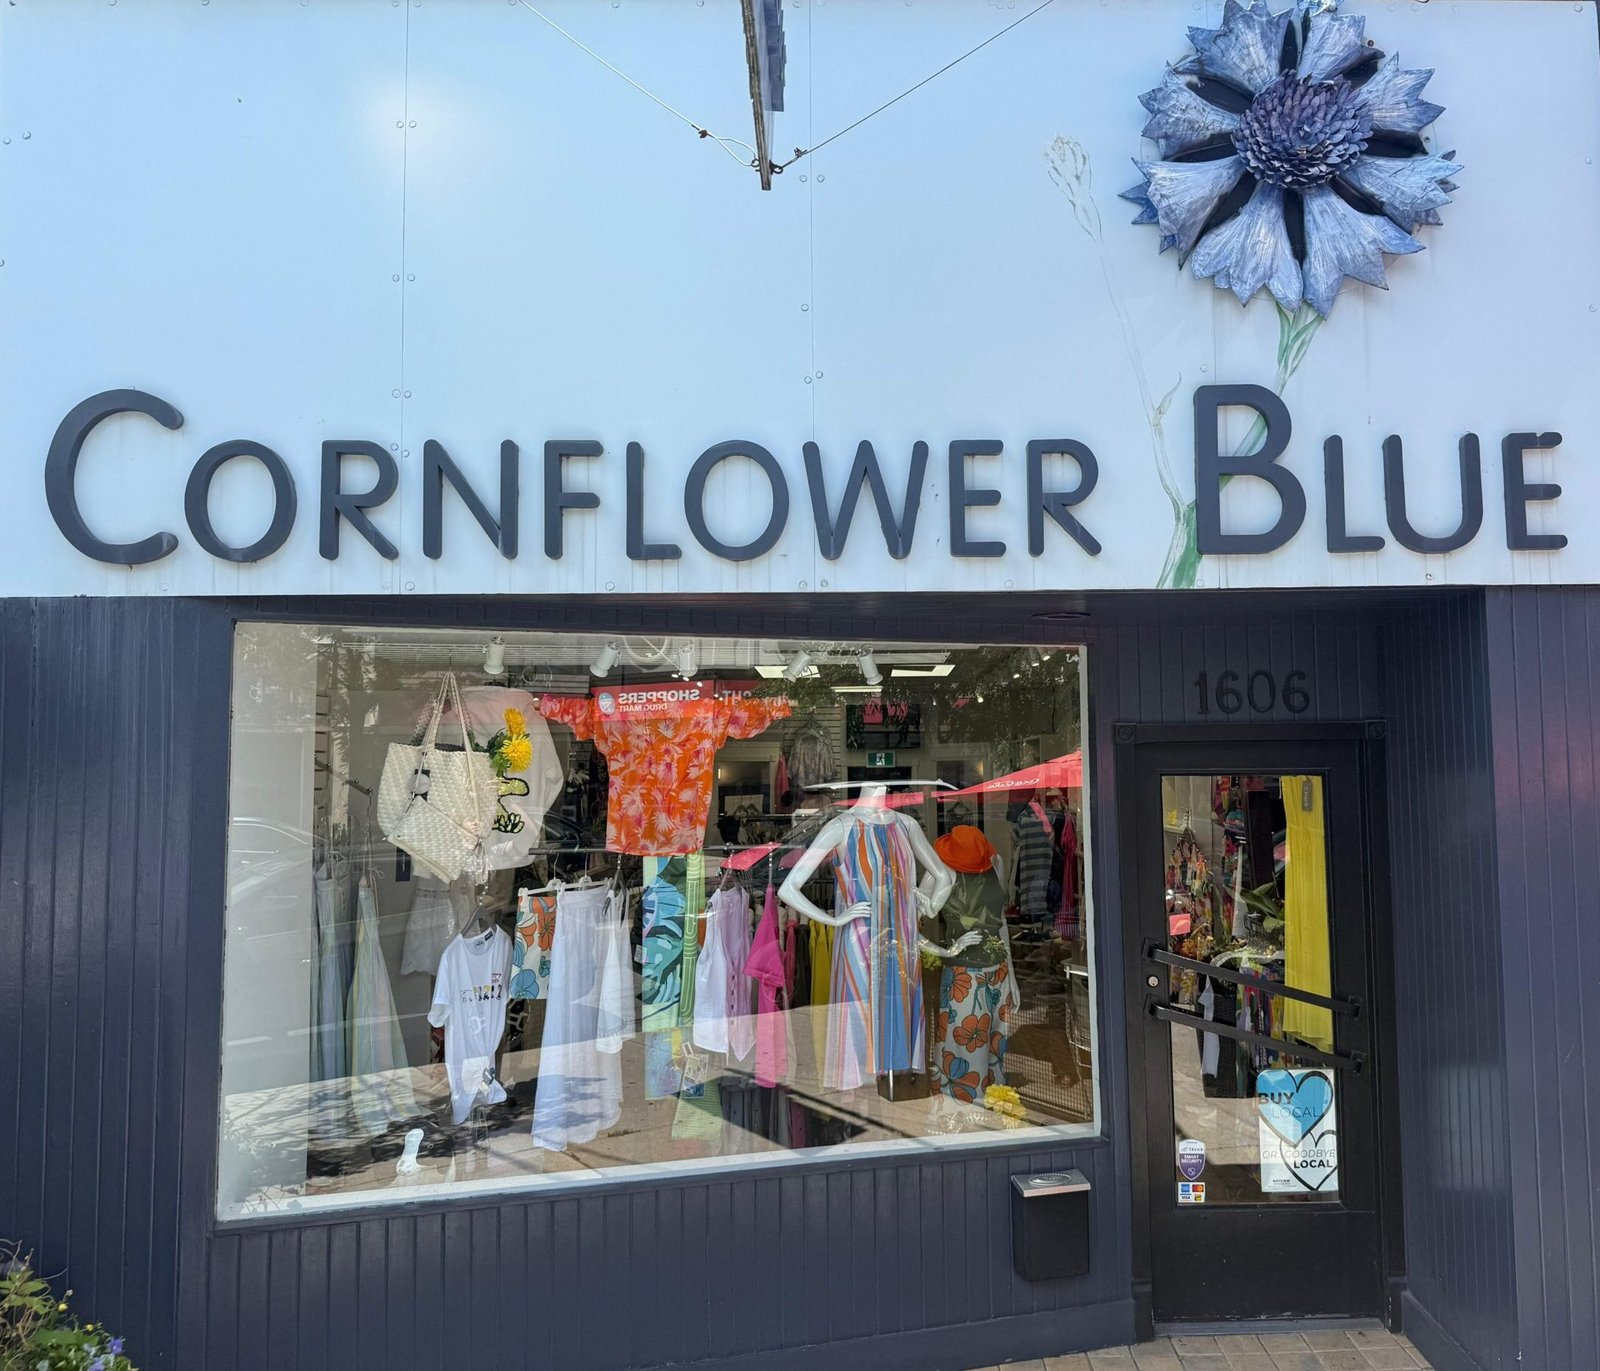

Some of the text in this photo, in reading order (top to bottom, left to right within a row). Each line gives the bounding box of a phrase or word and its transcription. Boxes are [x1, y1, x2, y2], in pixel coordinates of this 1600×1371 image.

[44, 383, 1567, 566] CORNFLOWER BLUE
[1193, 669, 1310, 715] 1606
[1258, 1092, 1294, 1105] BUY
[1272, 1106, 1321, 1119] LOCAL
[1262, 1149, 1336, 1159] OR GOODBYE
[1293, 1159, 1333, 1169] LOCAL
